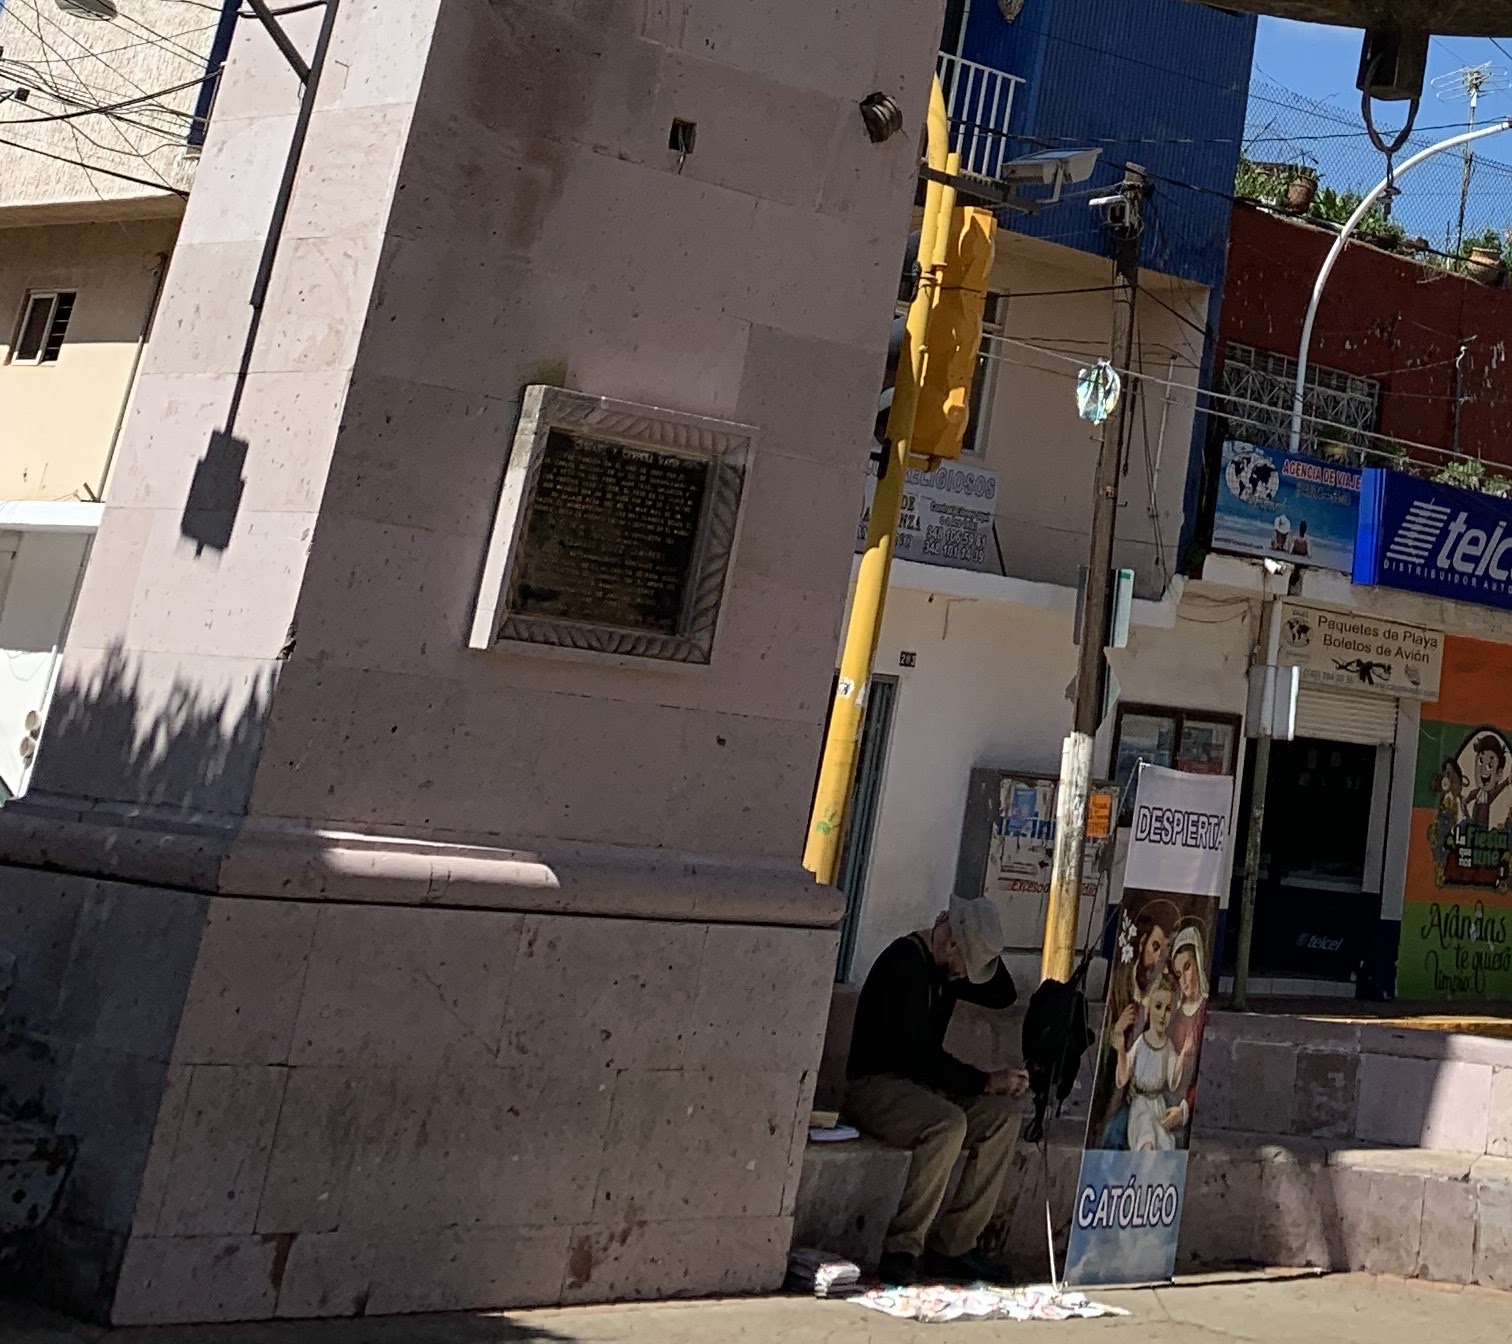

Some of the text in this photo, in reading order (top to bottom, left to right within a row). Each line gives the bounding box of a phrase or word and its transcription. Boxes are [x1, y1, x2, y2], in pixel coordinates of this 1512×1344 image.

[1282, 459, 1322, 483] AGENCIA
[1322, 466, 1336, 486] DE
[1383, 559, 1478, 589] DISTRIBUIDOR
[1317, 614, 1439, 650] Paquetes de Playa
[1323, 633, 1373, 655] Boletos
[1375, 643, 1392, 657] de
[1394, 646, 1431, 664] Avión
[1135, 805, 1227, 852] DESPIERTA
[1421, 900, 1507, 950] Arandas
[1454, 942, 1512, 993] te quiero
[1078, 1174, 1179, 1230] CATÓLICO
